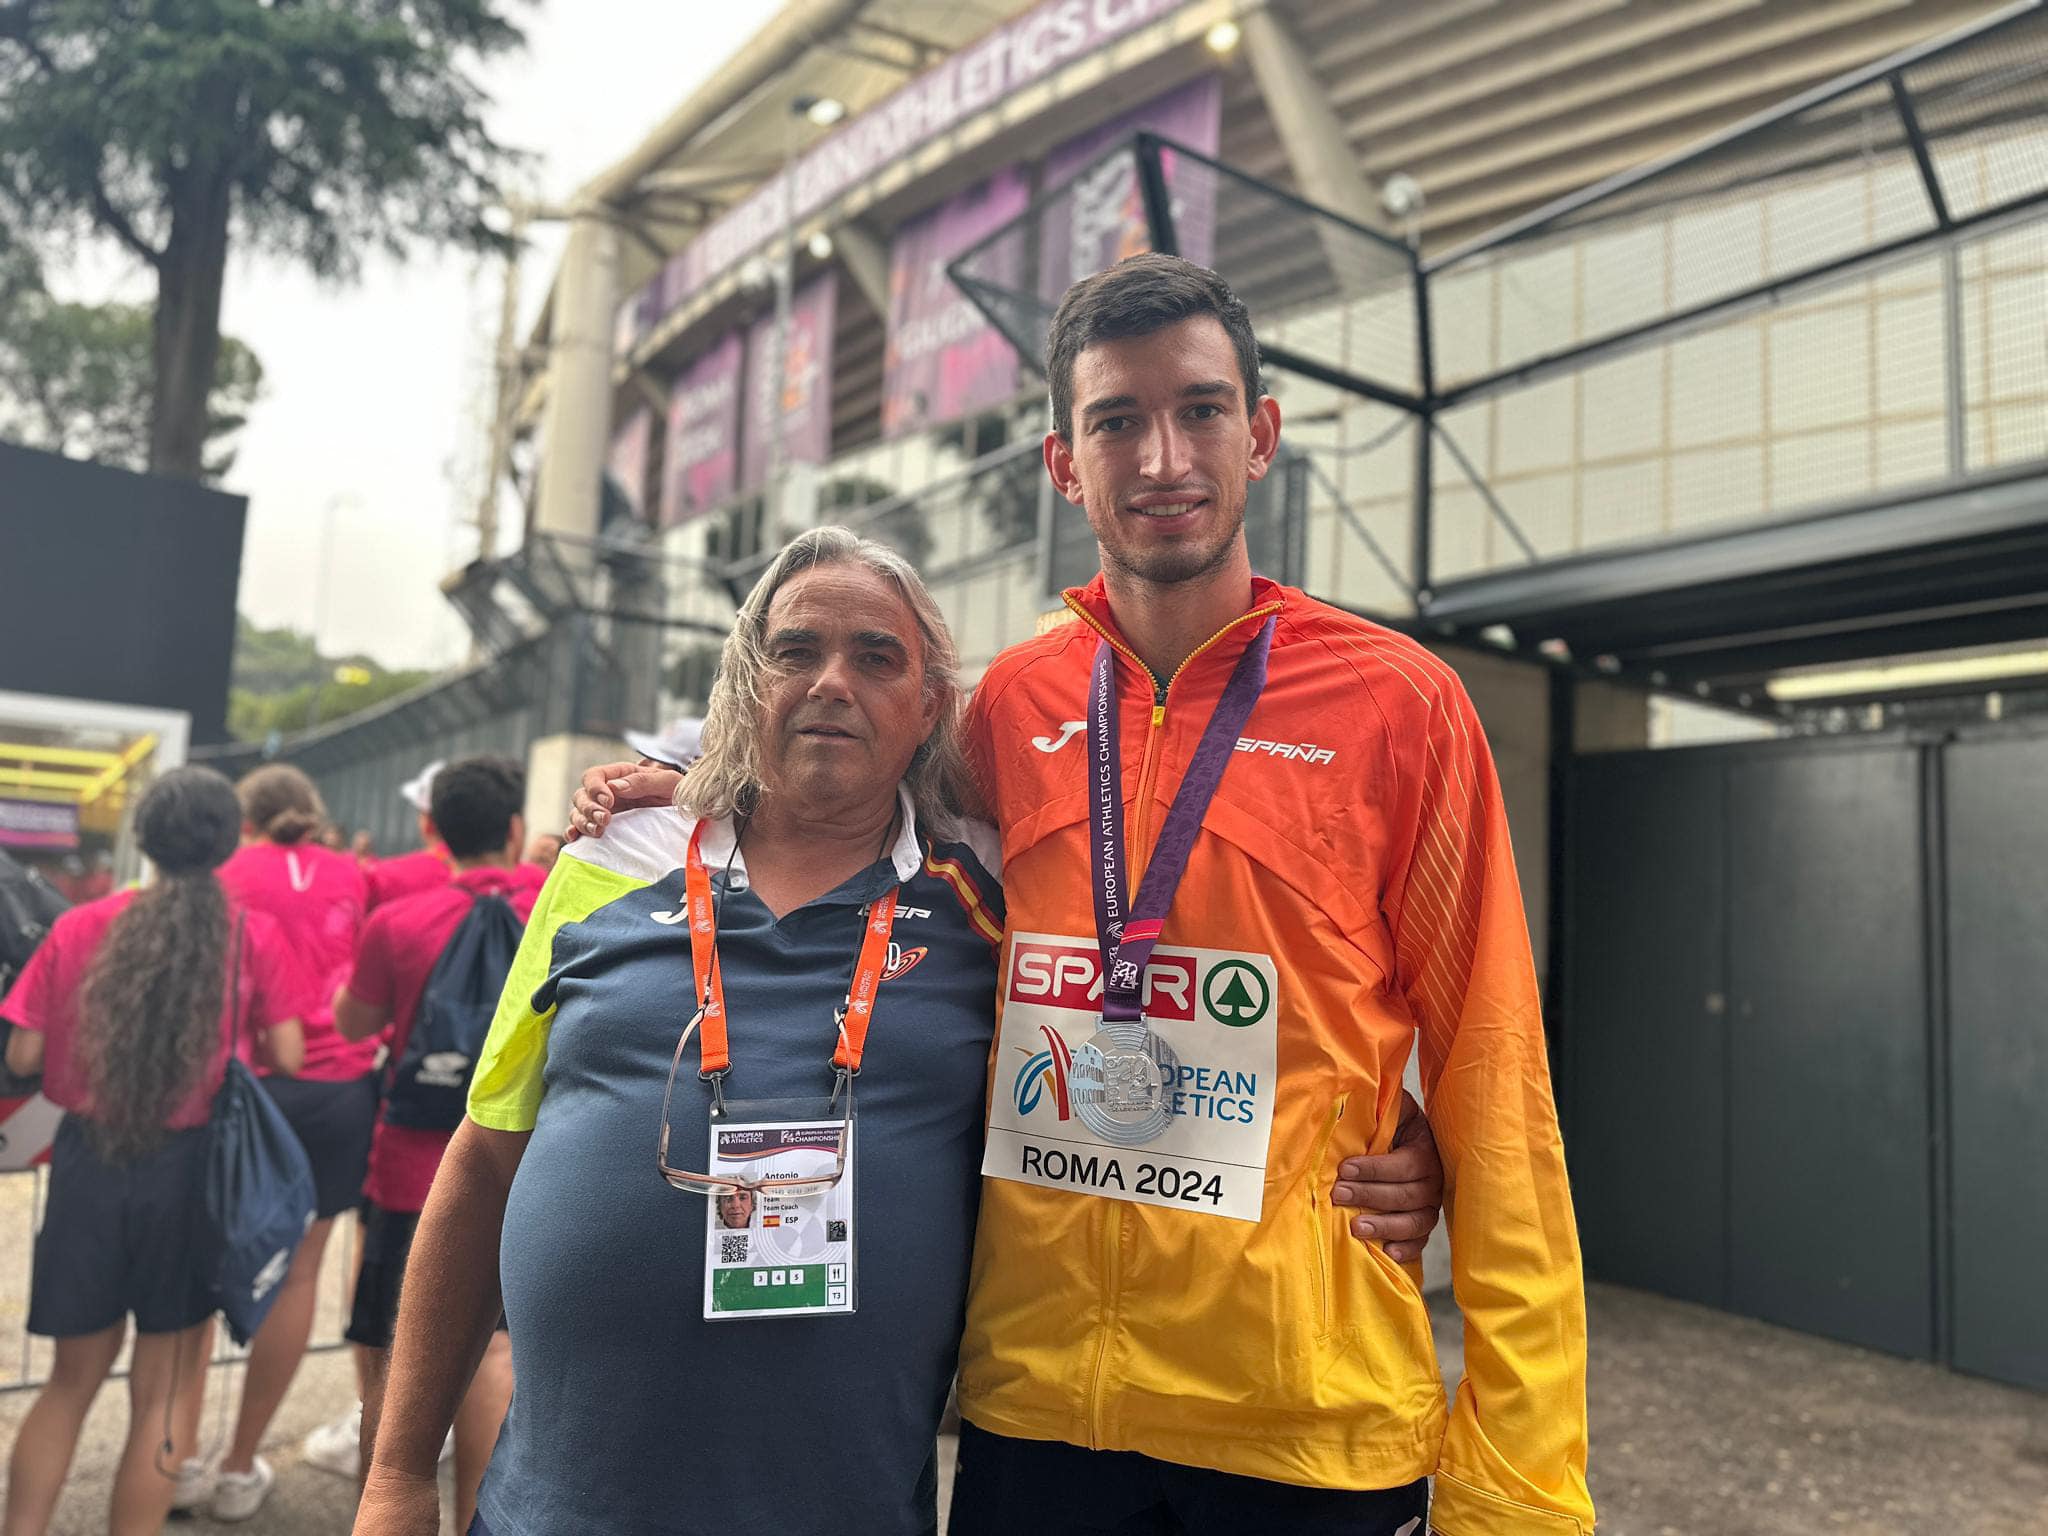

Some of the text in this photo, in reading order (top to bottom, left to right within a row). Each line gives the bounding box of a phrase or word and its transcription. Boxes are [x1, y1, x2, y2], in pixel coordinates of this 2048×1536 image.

[1233, 737, 1337, 766] SPAÑA
[1097, 658, 1119, 918] EUROPEAN ATHLETICS CHAMPIONSHIPS
[1172, 1091, 1254, 1124] ETICS
[765, 1172, 799, 1180] Antonio
[1021, 1145, 1224, 1205] ROMA 2024
[785, 1216, 799, 1224] ESP
[832, 1292, 841, 1300] T3
